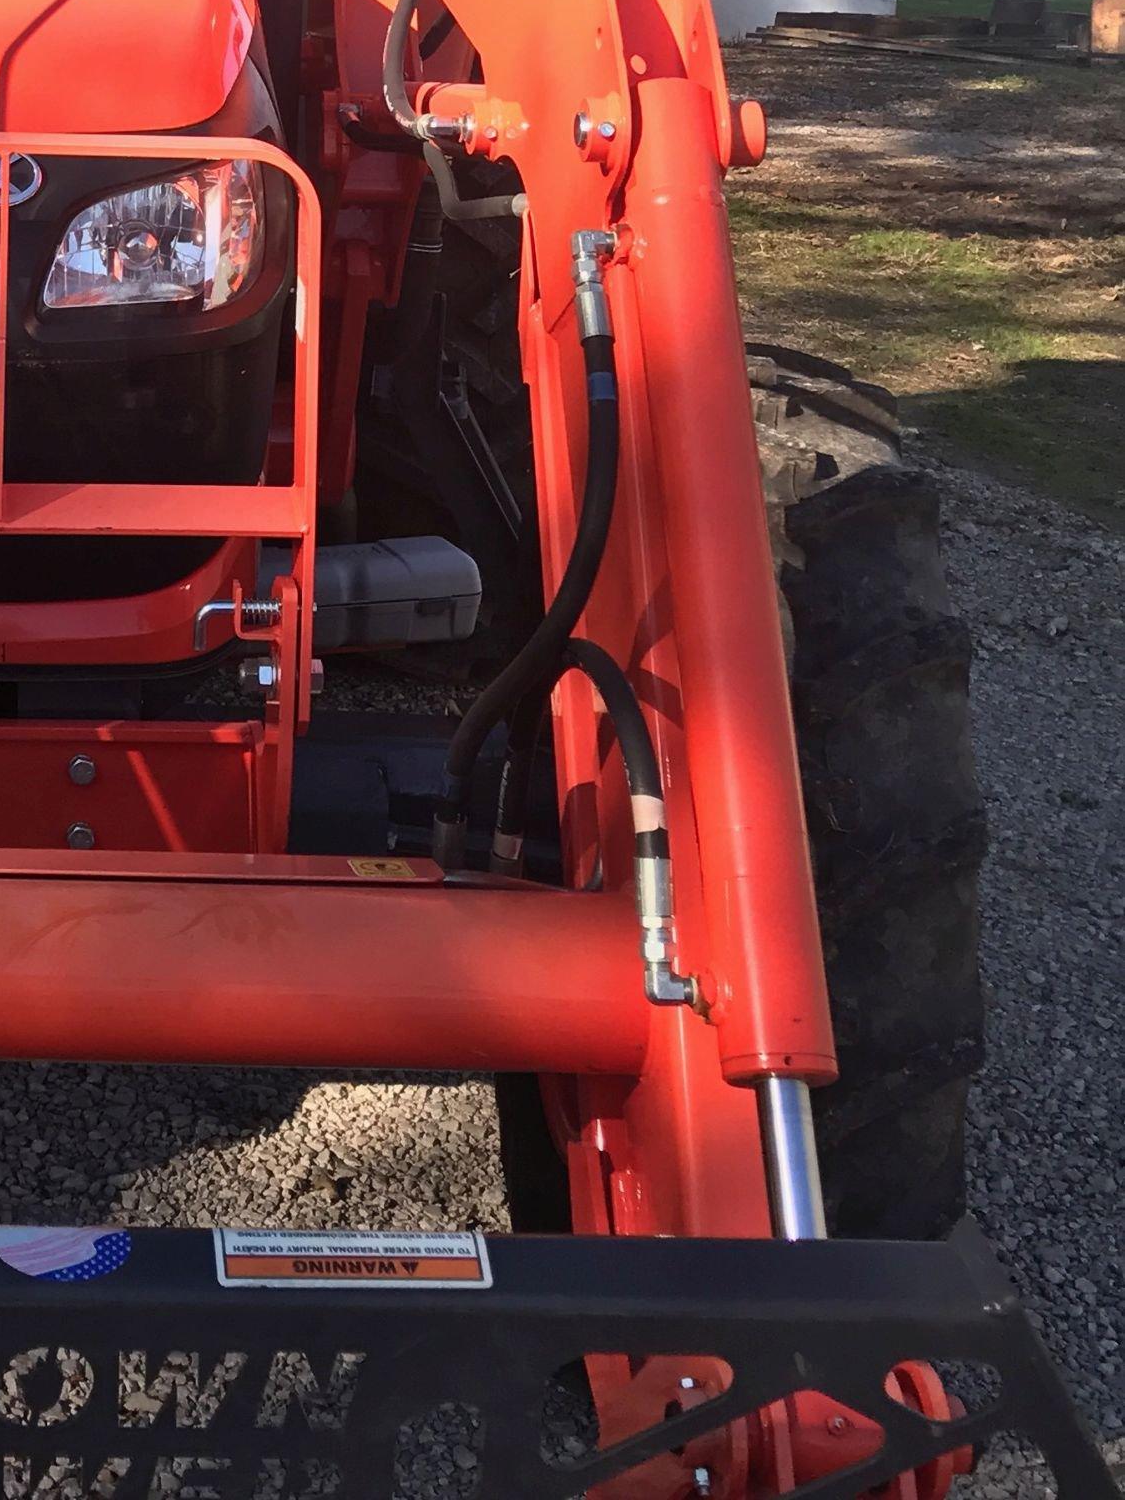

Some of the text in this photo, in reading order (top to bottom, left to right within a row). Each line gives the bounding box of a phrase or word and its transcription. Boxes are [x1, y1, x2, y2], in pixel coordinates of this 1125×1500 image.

[232, 1245, 266, 1253] DEATH
[268, 1245, 284, 1253] OR
[286, 1245, 323, 1253] INJURY
[327, 1246, 379, 1254] PERSONAL
[381, 1246, 422, 1254] SEVERE
[293, 1260, 397, 1274] WARNING
